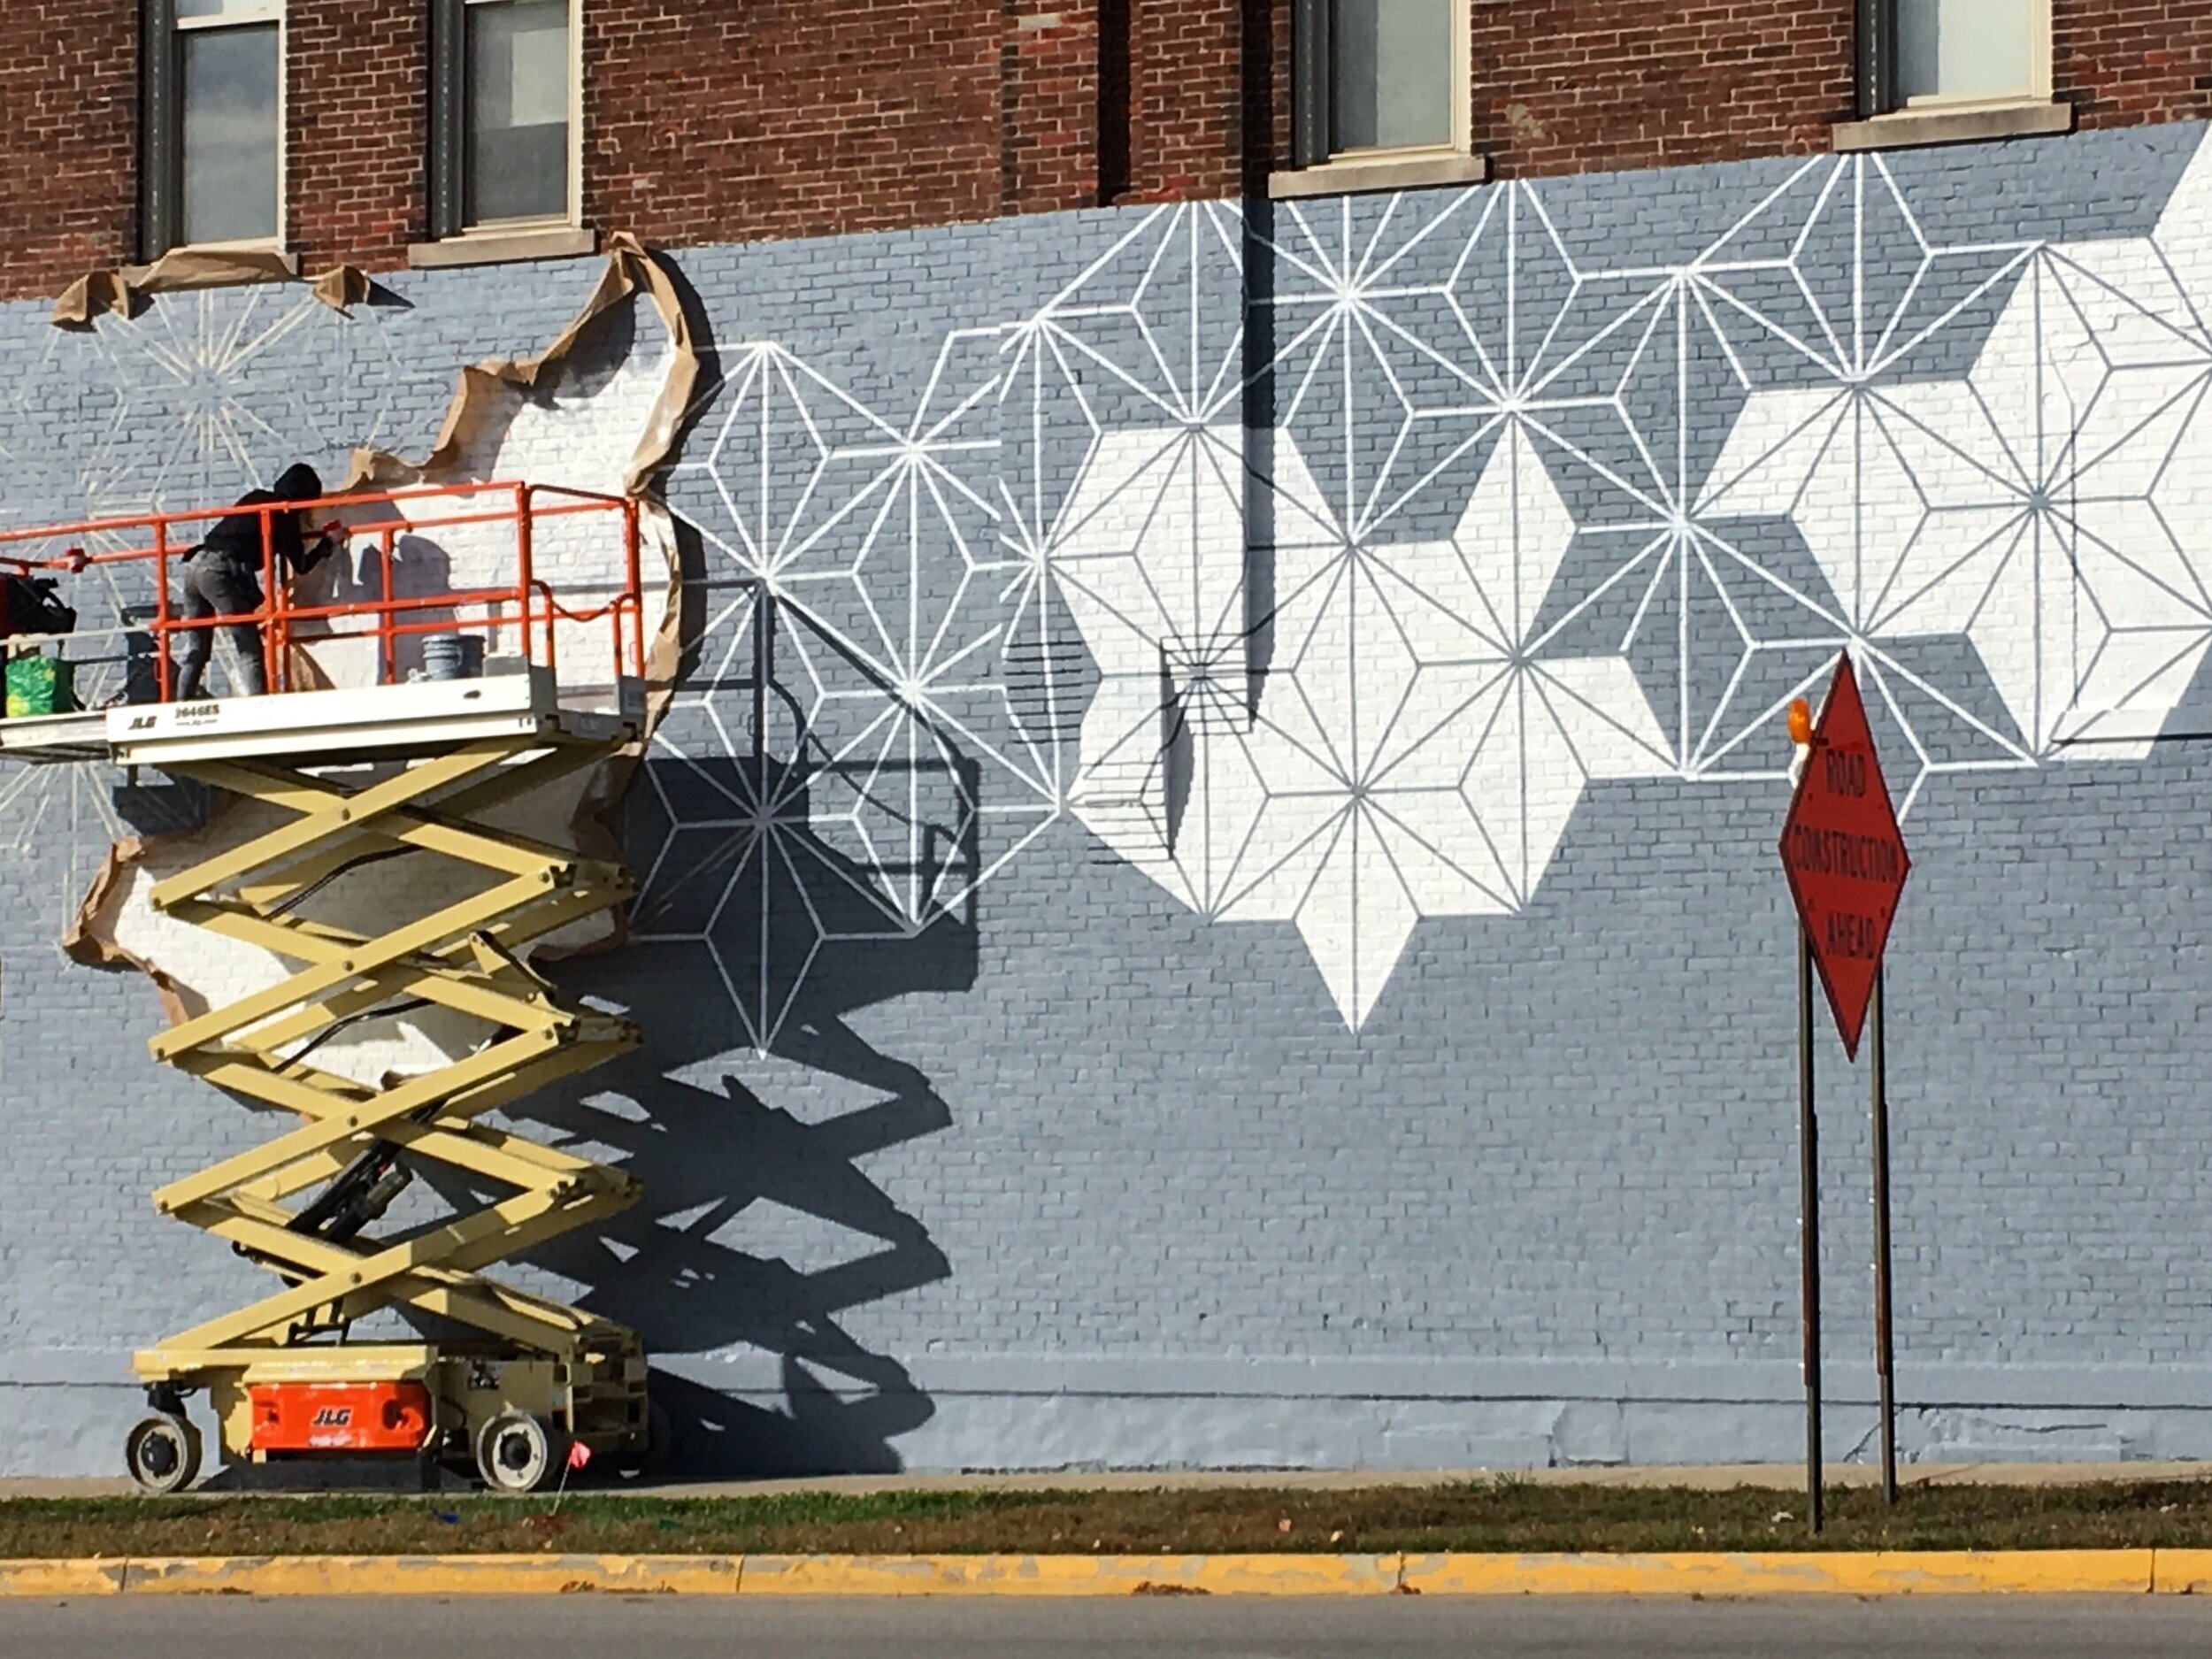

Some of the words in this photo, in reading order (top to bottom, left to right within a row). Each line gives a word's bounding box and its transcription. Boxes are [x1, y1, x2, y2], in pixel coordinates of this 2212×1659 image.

[1826, 749, 1866, 797] ROAD
[1793, 826, 1900, 882] CONSTRUCTION
[1825, 911, 1876, 959] AHEAD
[312, 1408, 351, 1425] JLG
